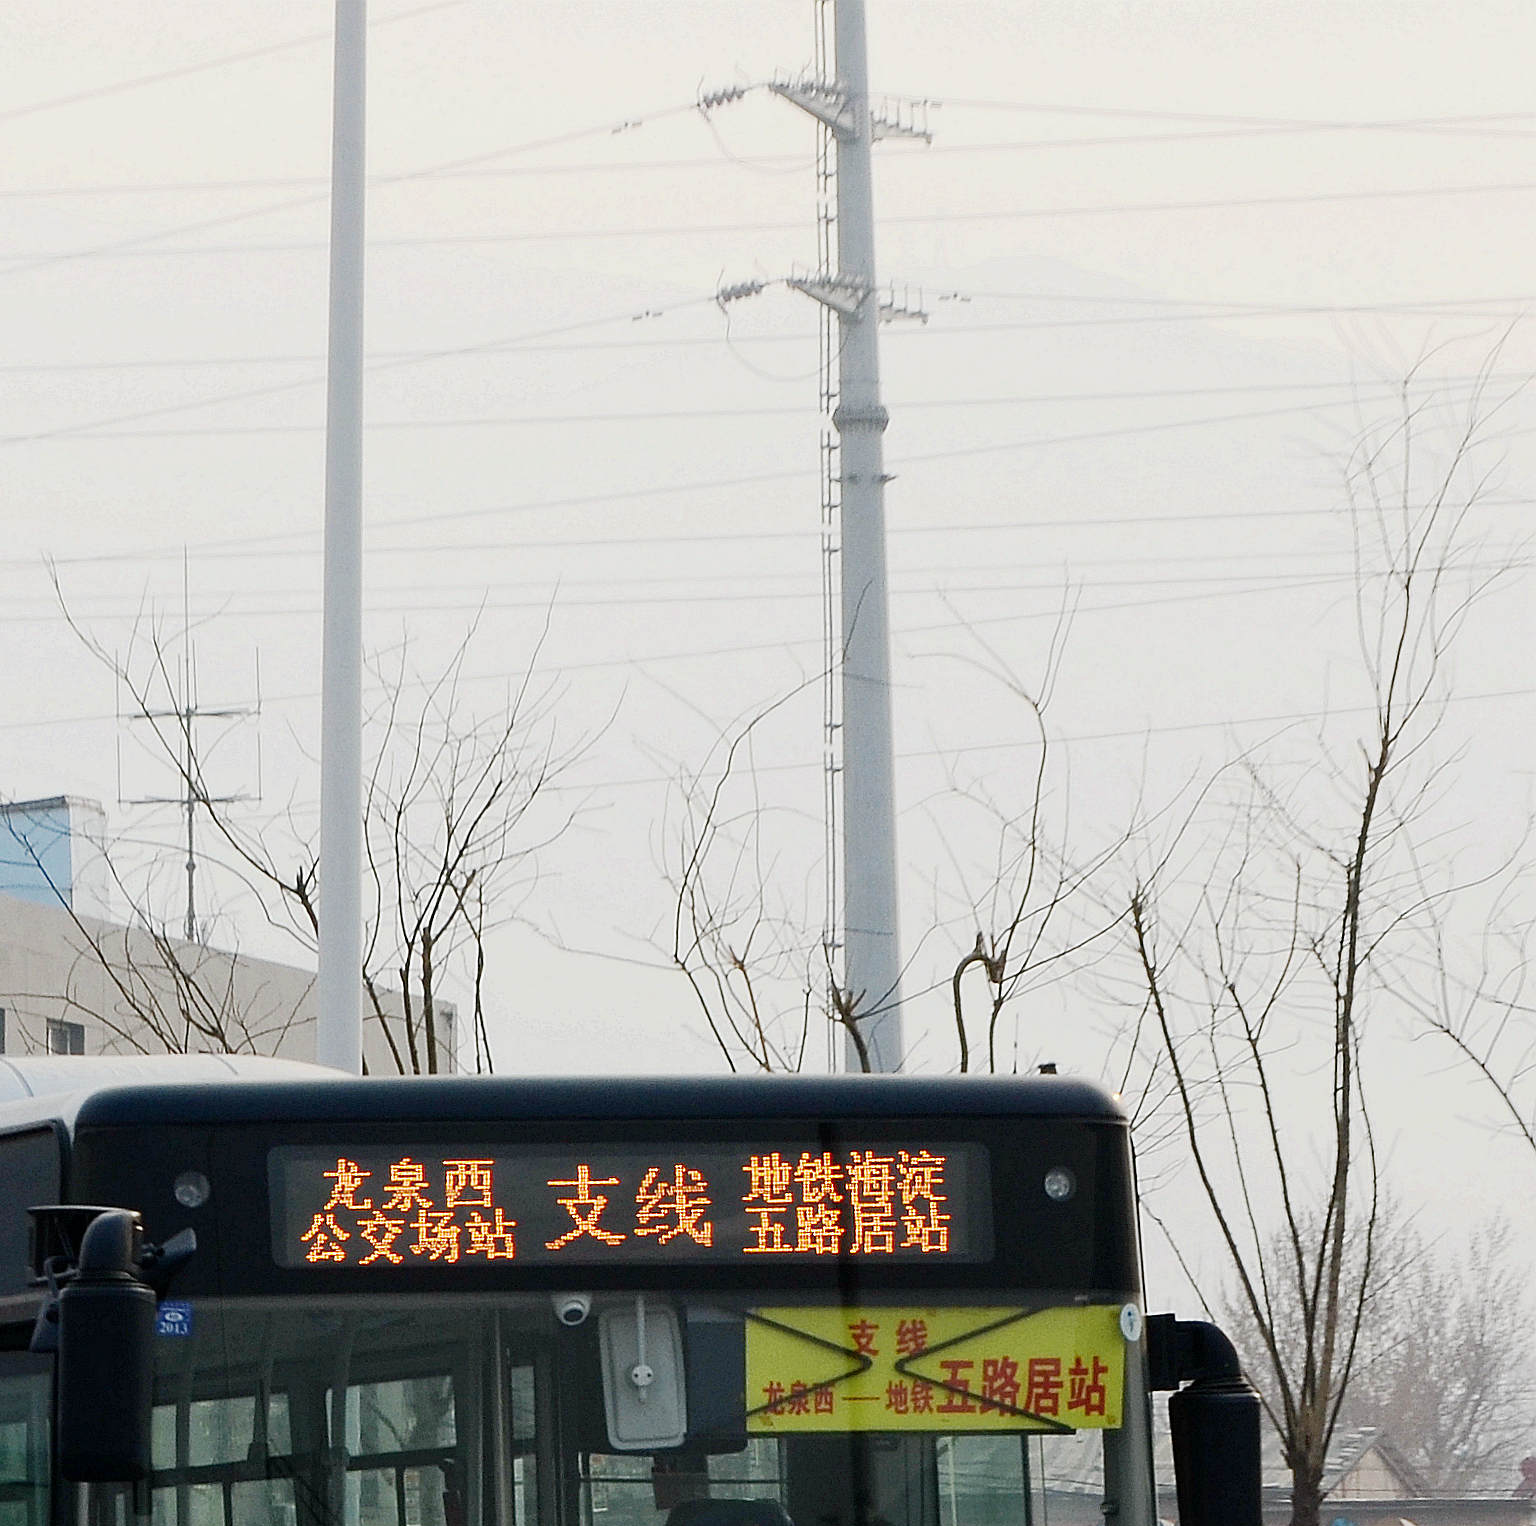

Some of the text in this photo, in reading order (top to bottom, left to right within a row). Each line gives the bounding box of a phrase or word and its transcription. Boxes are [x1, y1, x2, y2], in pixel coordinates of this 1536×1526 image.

[323, 1157, 495, 1211] 龙泉西
[741, 1149, 949, 1202] 地铁海淀
[544, 1163, 715, 1250] 支线
[742, 1202, 951, 1255] 五路居站
[300, 1208, 517, 1266] 公交场站
[848, 1318, 929, 1356] 支线
